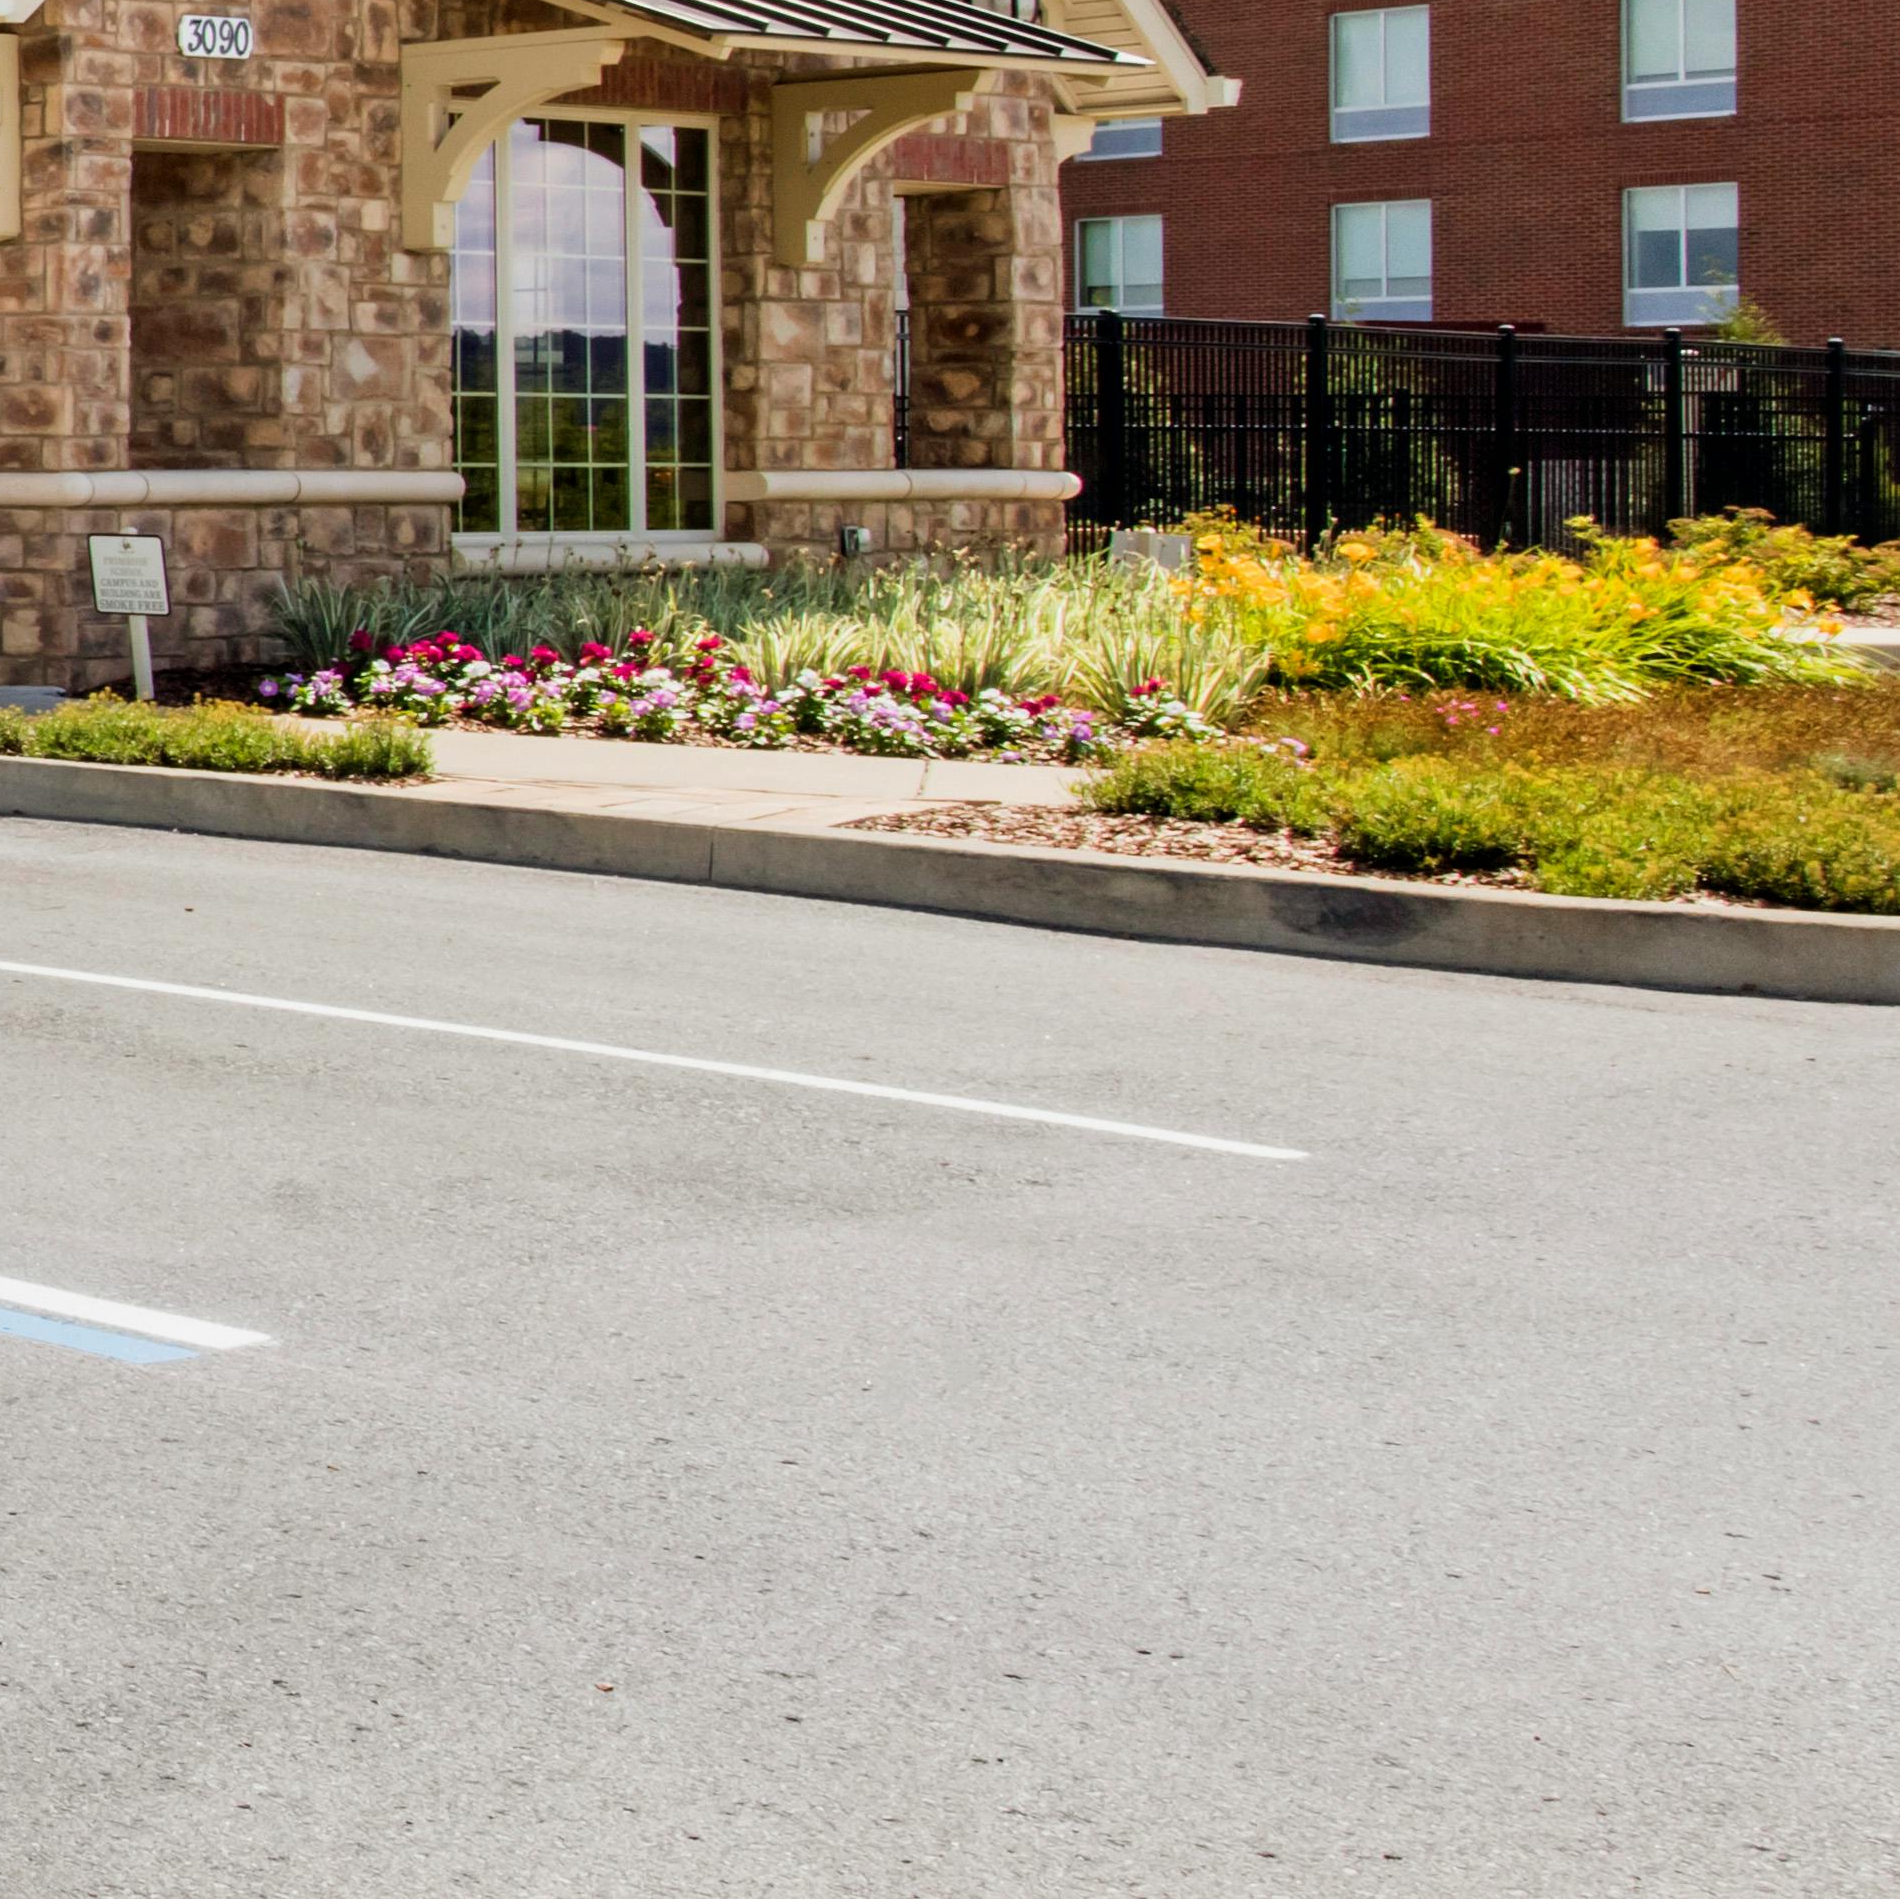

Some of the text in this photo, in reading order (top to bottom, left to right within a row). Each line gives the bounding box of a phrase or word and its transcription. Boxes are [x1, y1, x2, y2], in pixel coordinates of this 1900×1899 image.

[187, 18, 249, 56] 3090
[101, 578, 159, 589] CAMPUS AND
[101, 589, 162, 600] BUILDING ARE
[100, 600, 165, 612] SMOKE FREE
